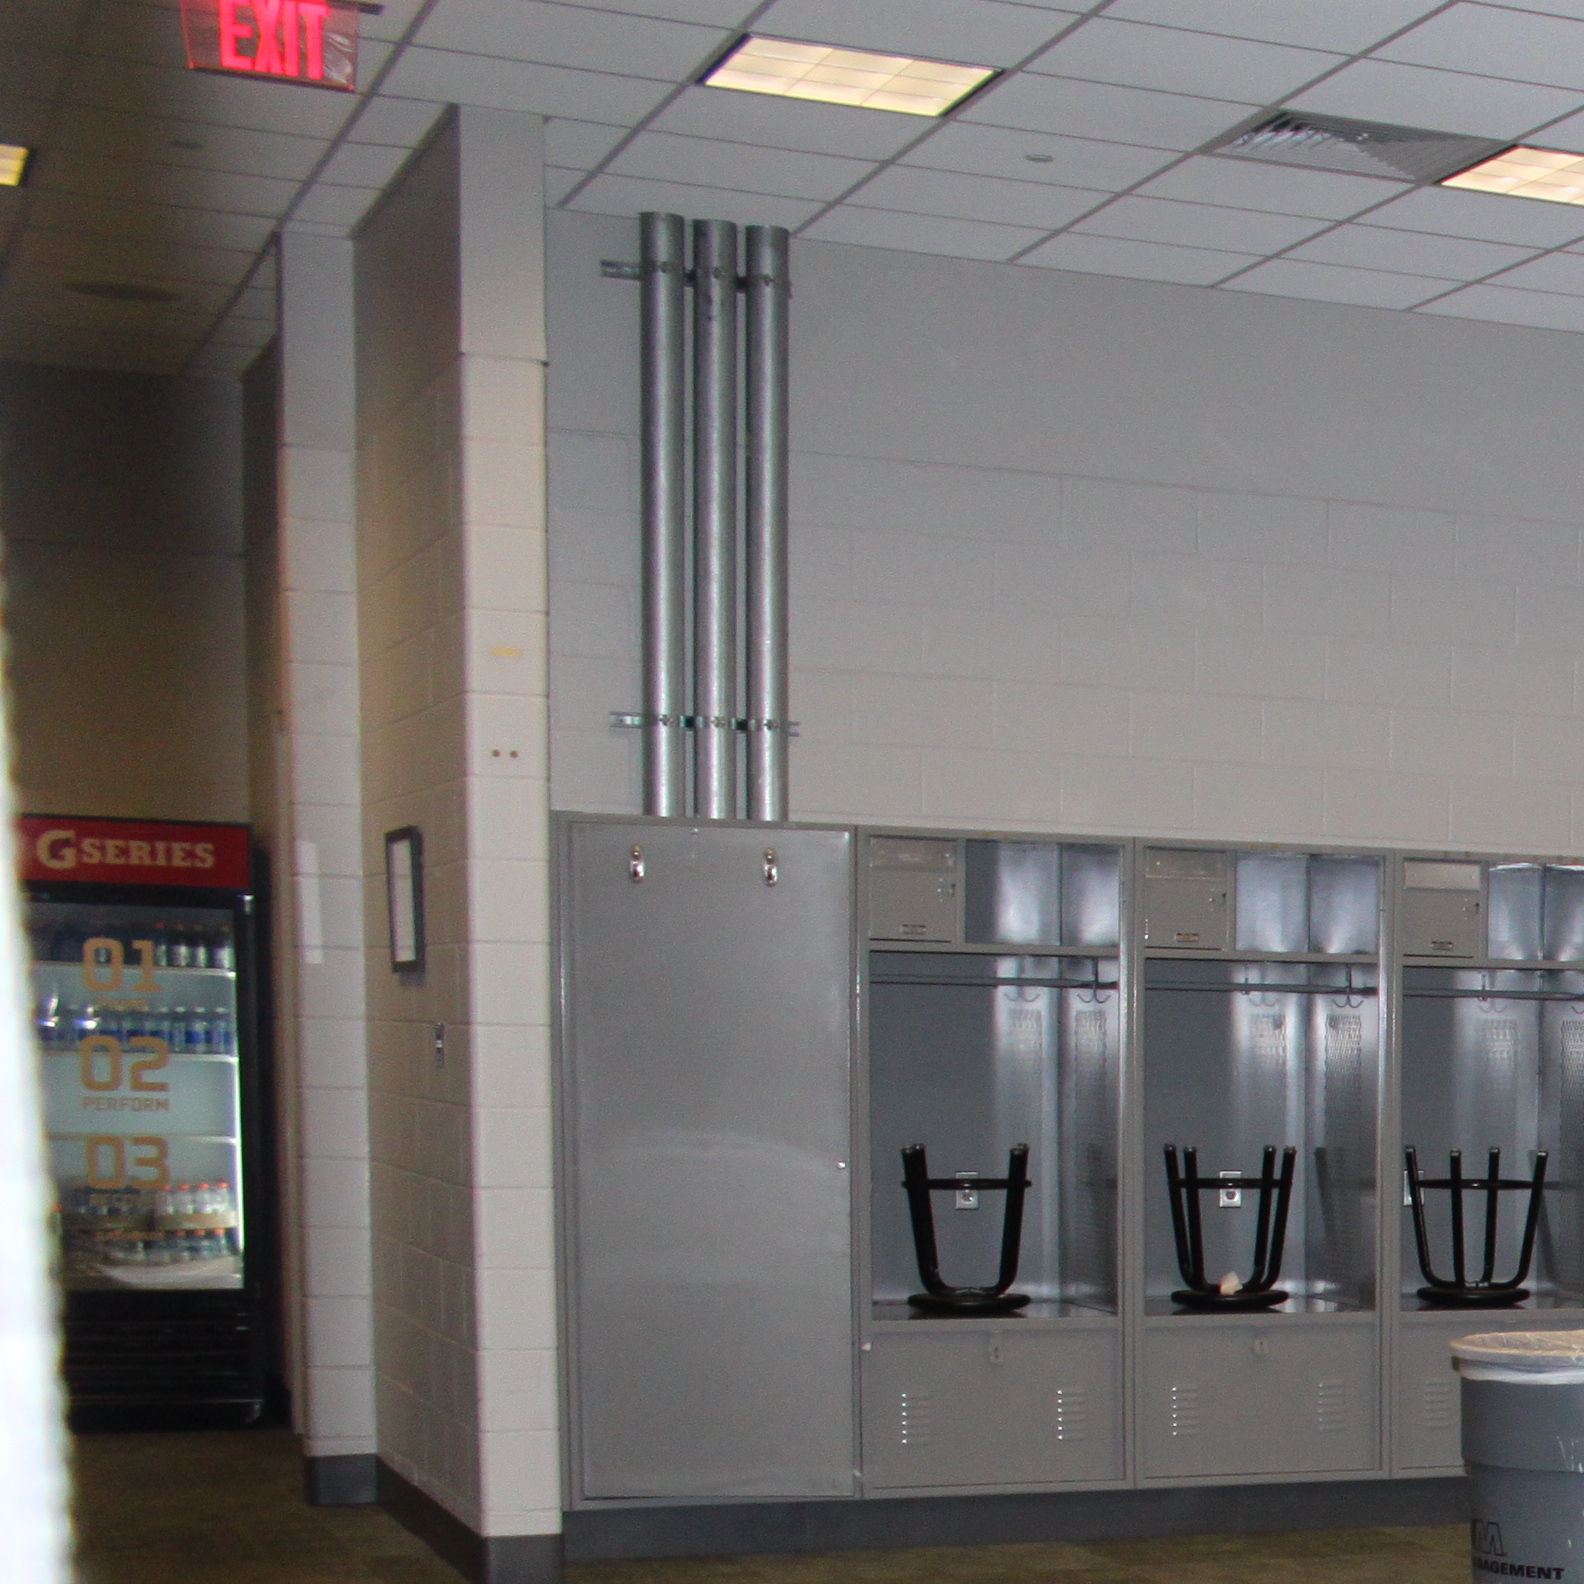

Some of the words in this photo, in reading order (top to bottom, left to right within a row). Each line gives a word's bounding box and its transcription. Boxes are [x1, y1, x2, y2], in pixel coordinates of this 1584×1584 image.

[219, 0, 331, 80] EXIT
[36, 829, 77, 869] G
[80, 837, 216, 869] SERIES
[83, 937, 163, 993] 01
[81, 1035, 170, 1092] 02
[82, 1096, 170, 1112] PERFORM
[86, 1135, 169, 1190] 03
